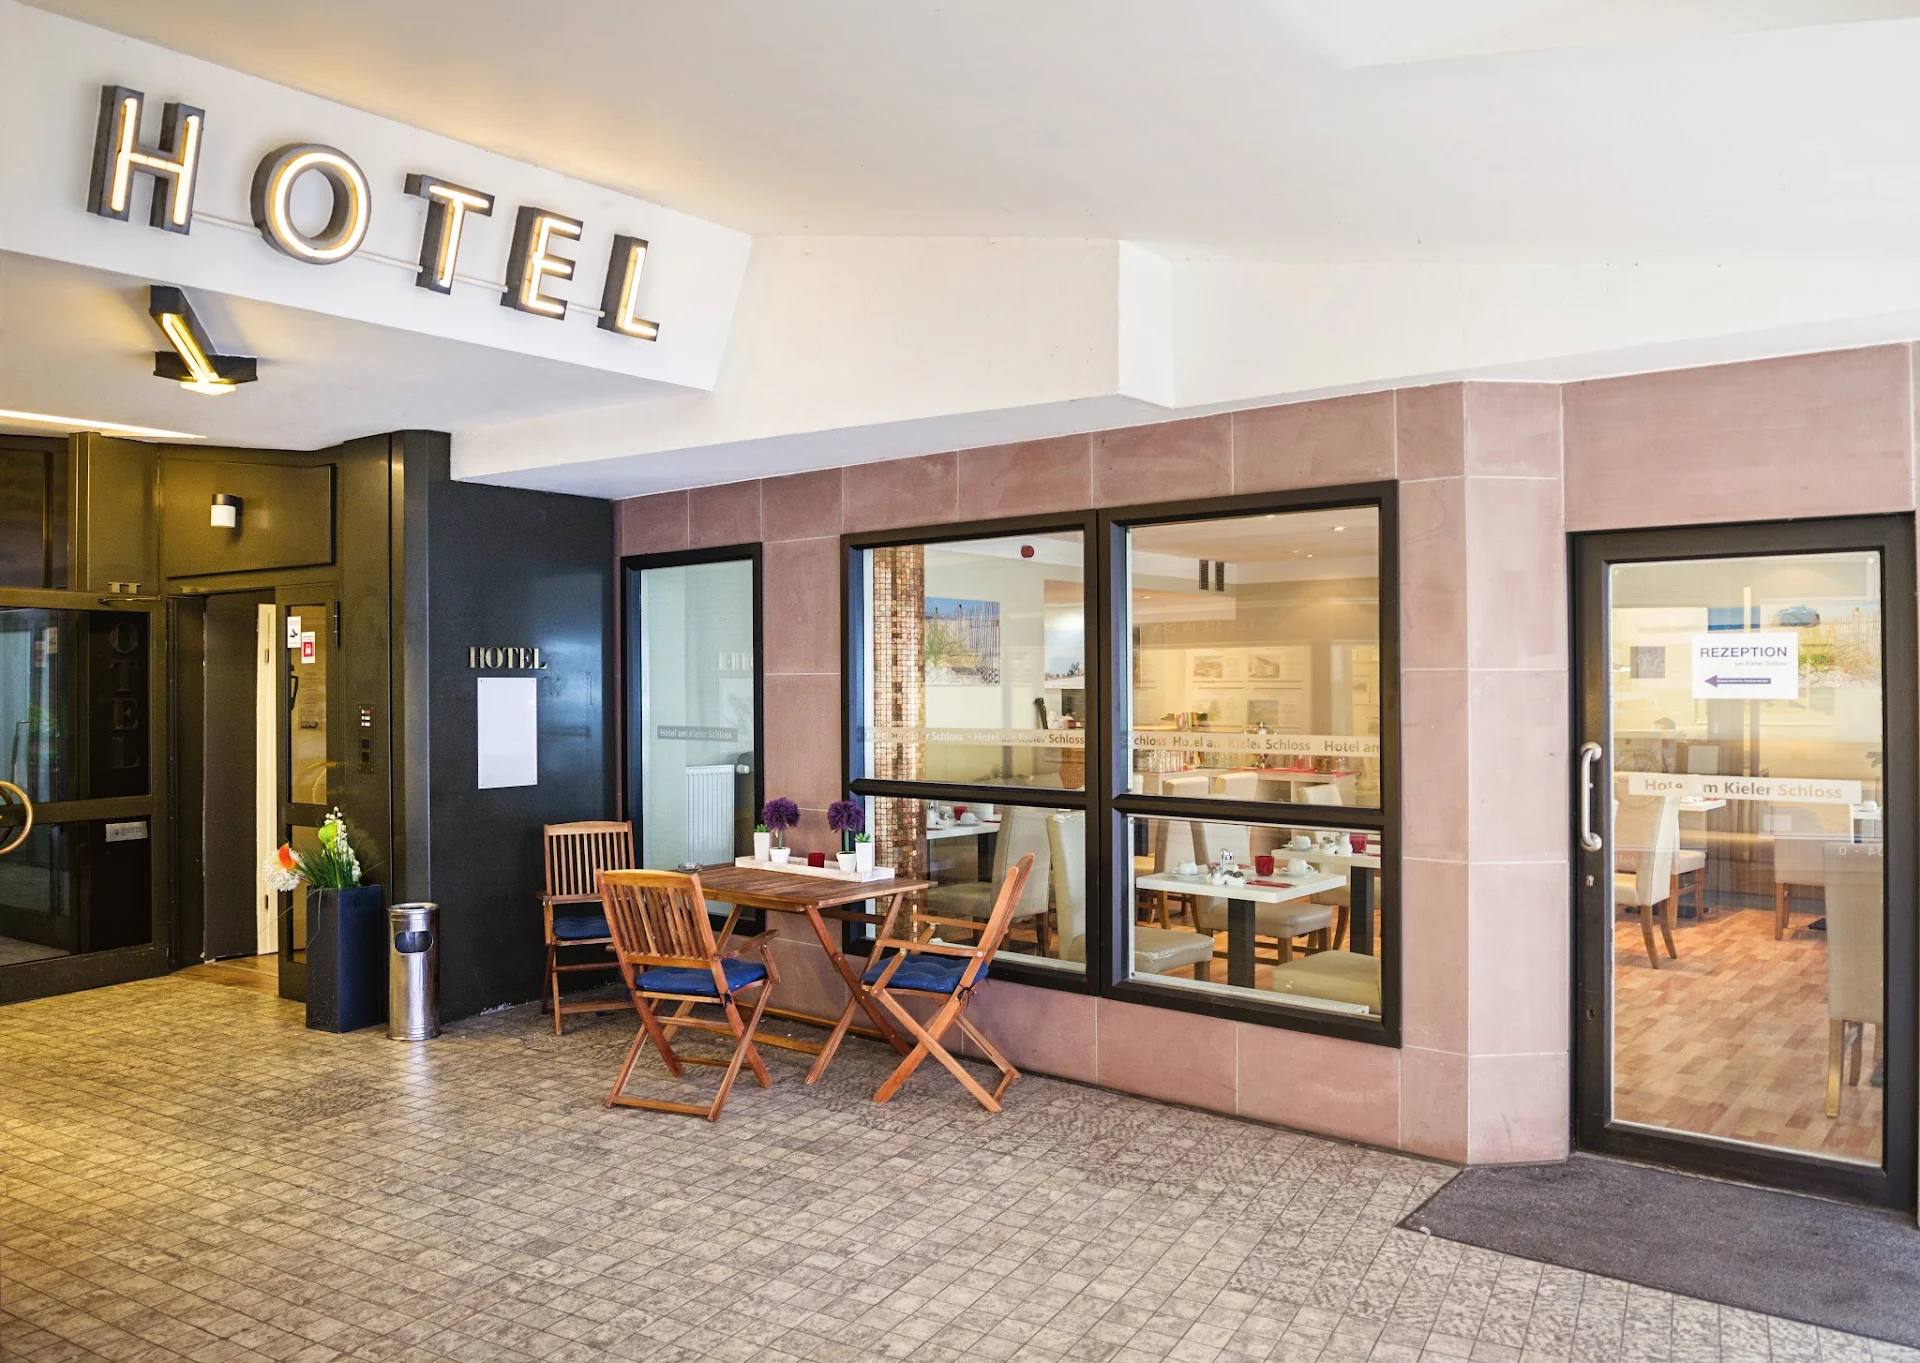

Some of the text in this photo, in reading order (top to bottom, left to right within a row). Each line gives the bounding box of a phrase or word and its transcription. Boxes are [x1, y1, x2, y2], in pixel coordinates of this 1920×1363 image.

[87, 85, 660, 342] HOTEL
[468, 646, 548, 670] HOTEL
[1700, 646, 1788, 658] REZEPTION
[931, 730, 963, 741] Schloss
[1049, 733, 1085, 744] Schloss
[1266, 738, 1311, 751] Schloss
[1324, 739, 1359, 753] Hotel
[1697, 783, 1718, 794] m
[1724, 781, 1772, 796] Kieler
[1777, 784, 1843, 799] Schloss
